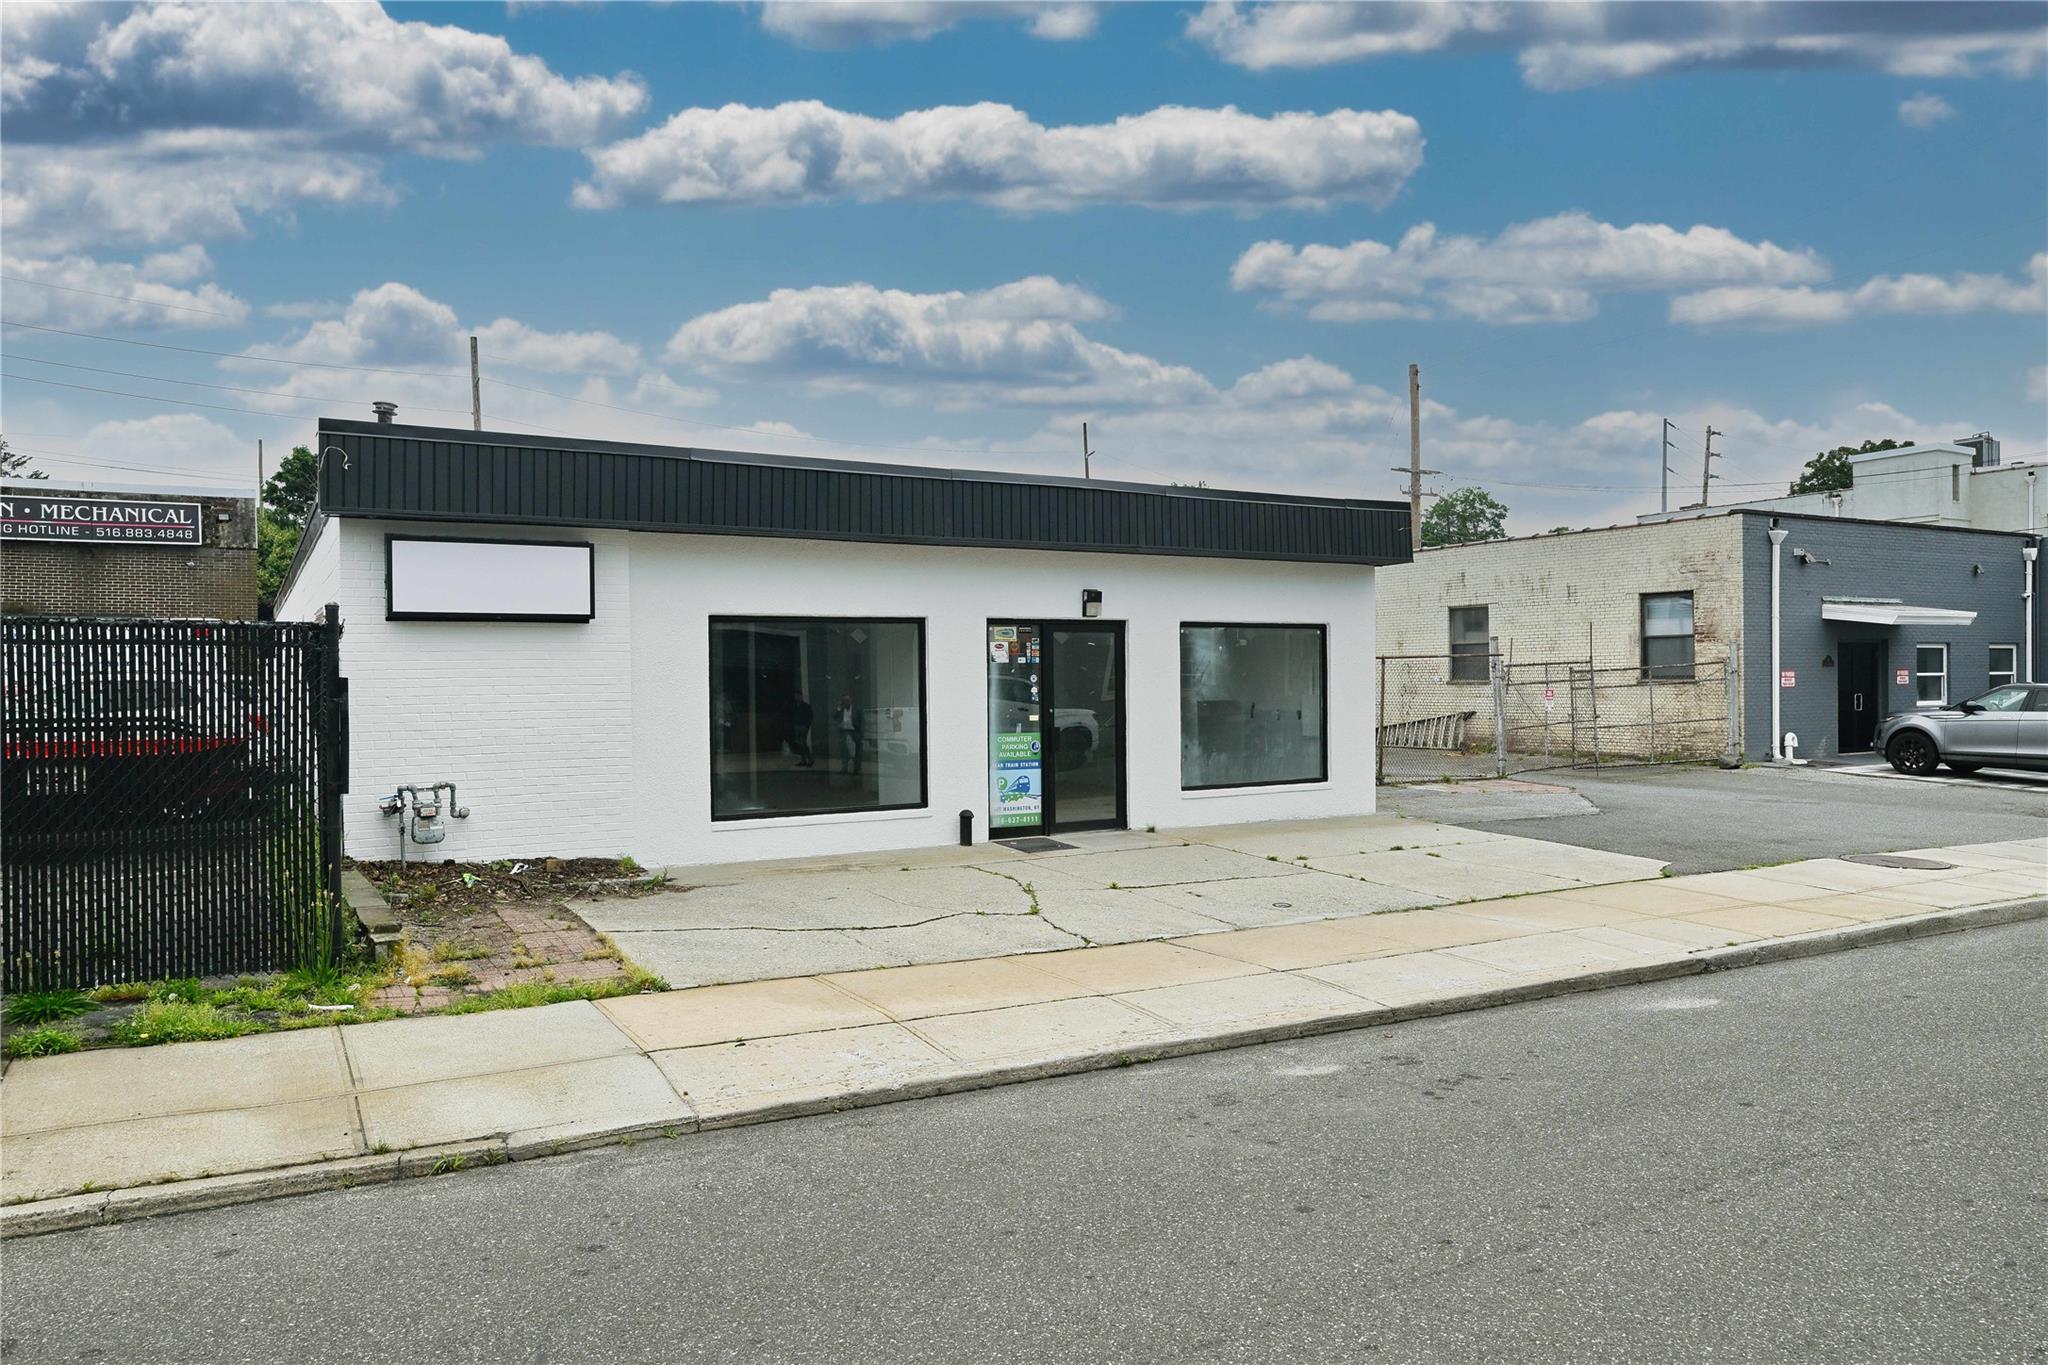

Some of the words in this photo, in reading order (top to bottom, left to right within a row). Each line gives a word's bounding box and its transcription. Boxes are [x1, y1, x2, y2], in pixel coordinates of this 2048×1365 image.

[41, 504, 192, 524] MECHANICAL
[18, 524, 80, 536] HOTLINE
[96, 527, 193, 539] 516.883.4848
